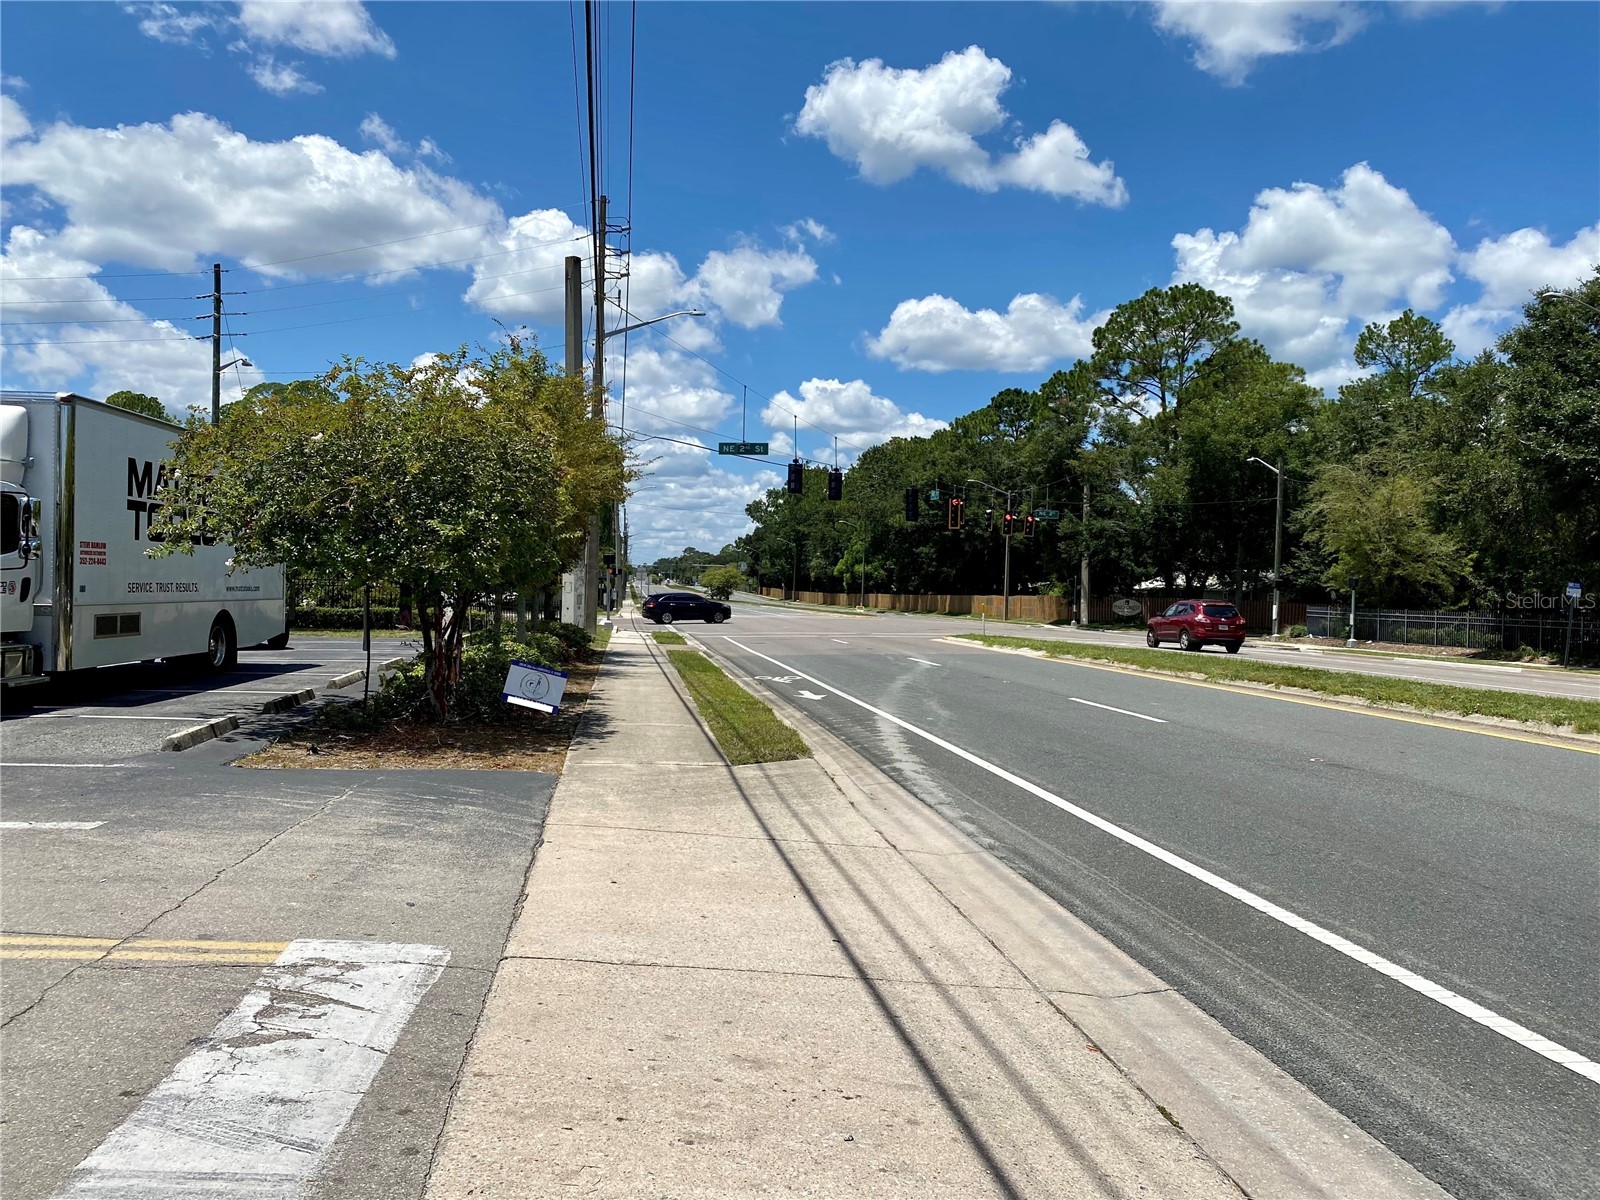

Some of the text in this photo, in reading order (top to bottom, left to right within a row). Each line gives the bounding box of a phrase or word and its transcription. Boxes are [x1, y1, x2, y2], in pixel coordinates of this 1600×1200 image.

[755, 445, 764, 453] St
[128, 582, 200, 593] SERVICE. TRUST. RESULTS.
